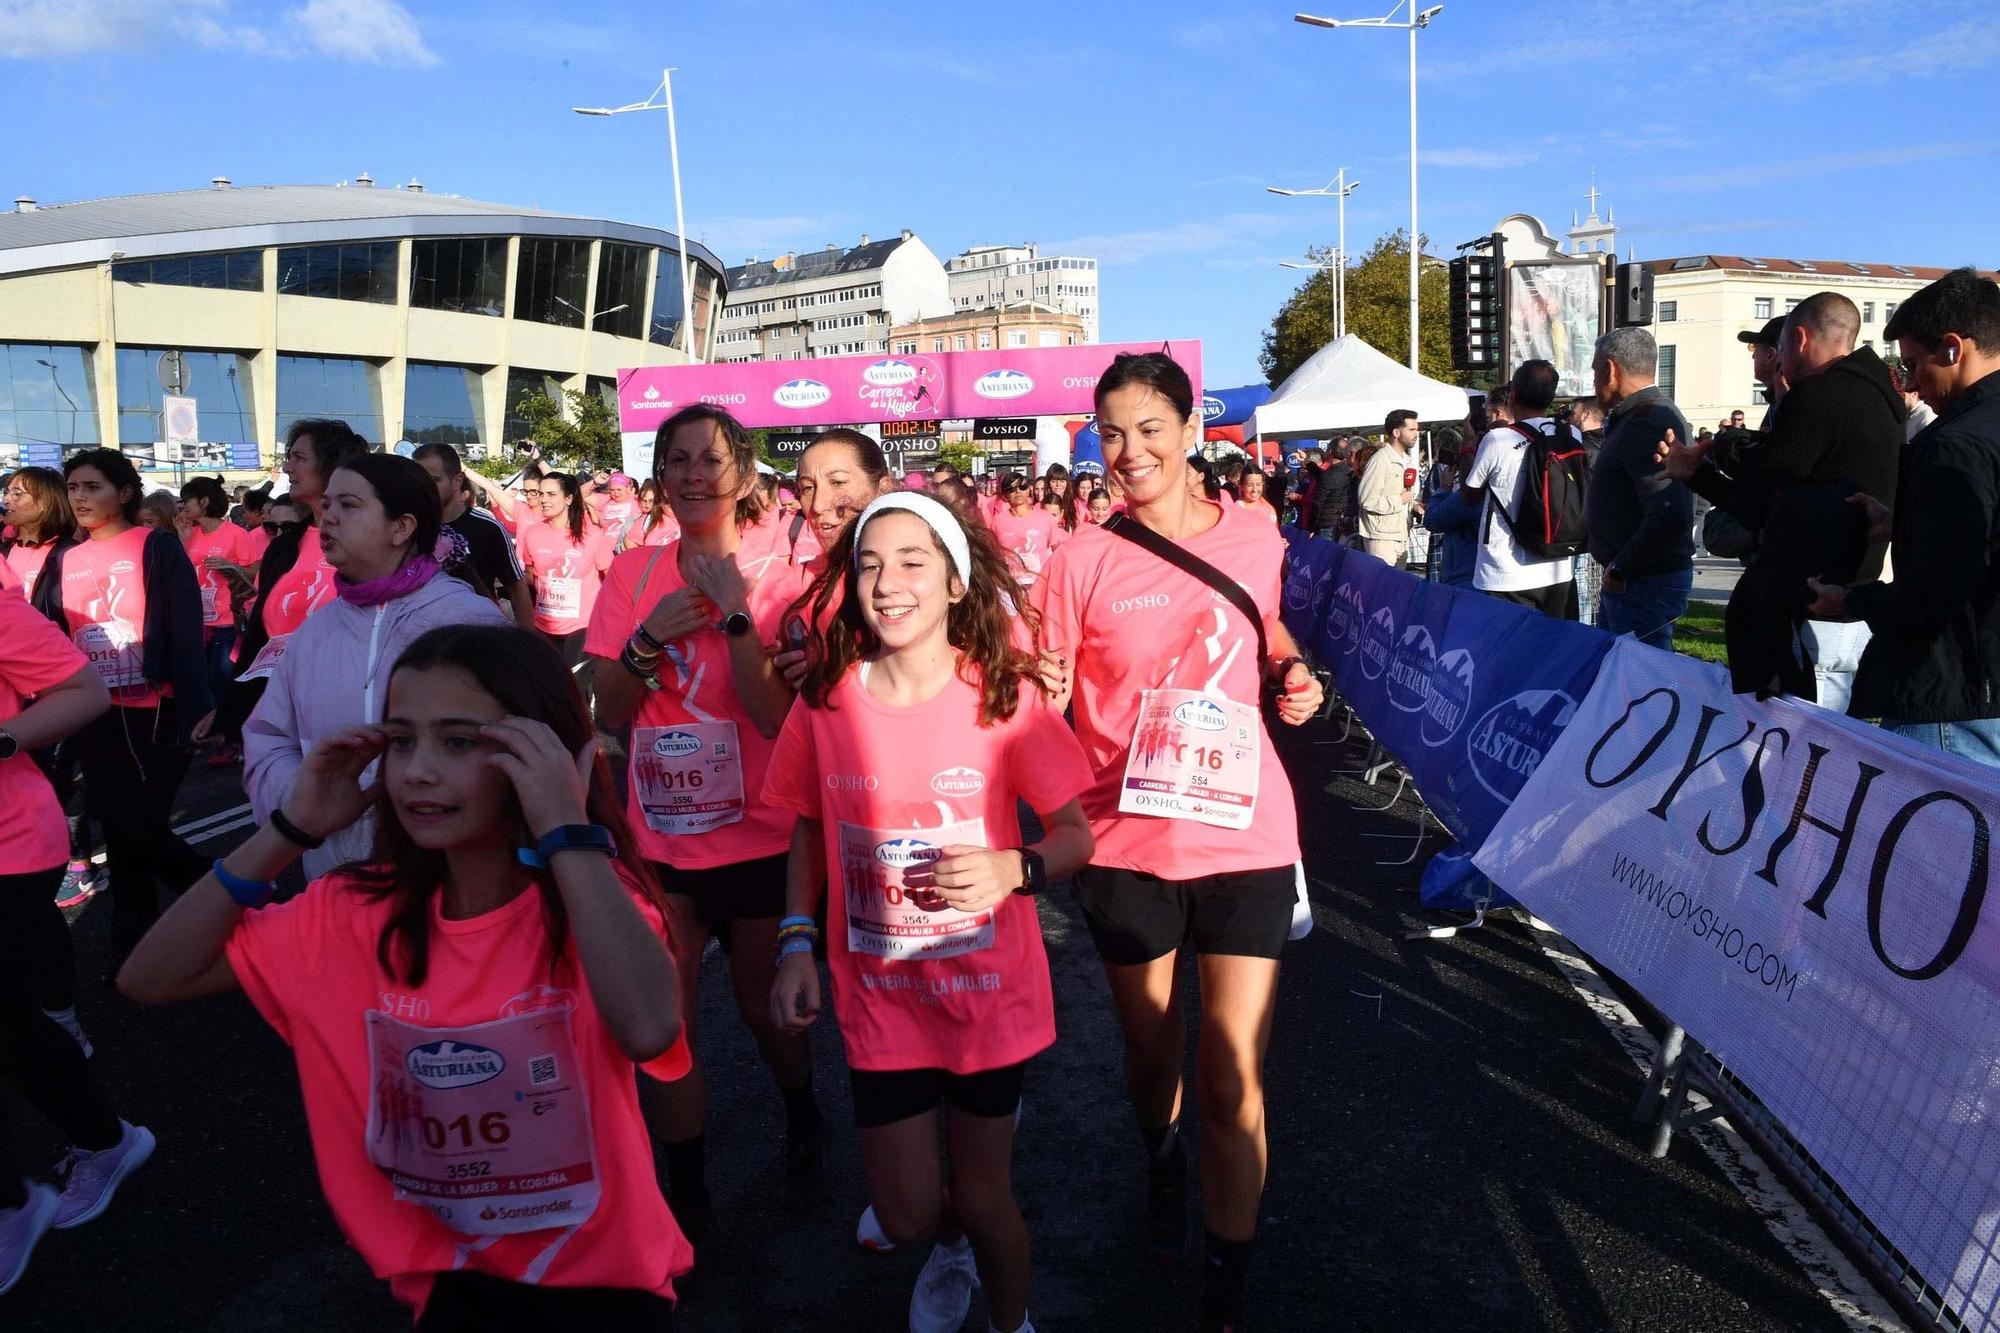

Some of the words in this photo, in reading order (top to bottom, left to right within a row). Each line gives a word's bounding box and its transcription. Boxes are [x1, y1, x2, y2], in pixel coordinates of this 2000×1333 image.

[980, 381, 1030, 393] ASTURIANA
[1063, 376, 1099, 389] OYSH
[700, 393, 746, 405] OYSHO
[778, 390, 827, 402] ASTURIANA
[858, 385, 904, 399] Carrera
[631, 400, 674, 410] Santander
[885, 398, 921, 418] Mujer
[982, 424, 1029, 435] OYSHO
[777, 441, 811, 452] OYSH
[882, 438, 937, 454] OYSHO
[1111, 593, 1169, 615] OYSHO
[656, 740, 699, 752] ASTURIANA
[1472, 712, 1542, 778] ASTUR
[662, 769, 704, 789] 016
[826, 774, 879, 792] OYSHO
[1135, 794, 1180, 810] OYSHO
[1584, 687, 1990, 981] OYSHO
[901, 915, 930, 925] 3545
[1612, 852, 1799, 1003] WWW.OYSHO.COM
[899, 926, 909, 936] LA
[861, 934, 903, 952] OYSHO
[933, 935, 979, 951] Santander
[930, 979, 949, 996] LA
[951, 972, 1001, 994] MUJER
[379, 992, 430, 1021] SHO
[412, 1055, 498, 1078] ASTURIANA
[423, 1110, 511, 1150] 016
[446, 1161, 491, 1179] 3552
[499, 1199, 573, 1220] Santander
